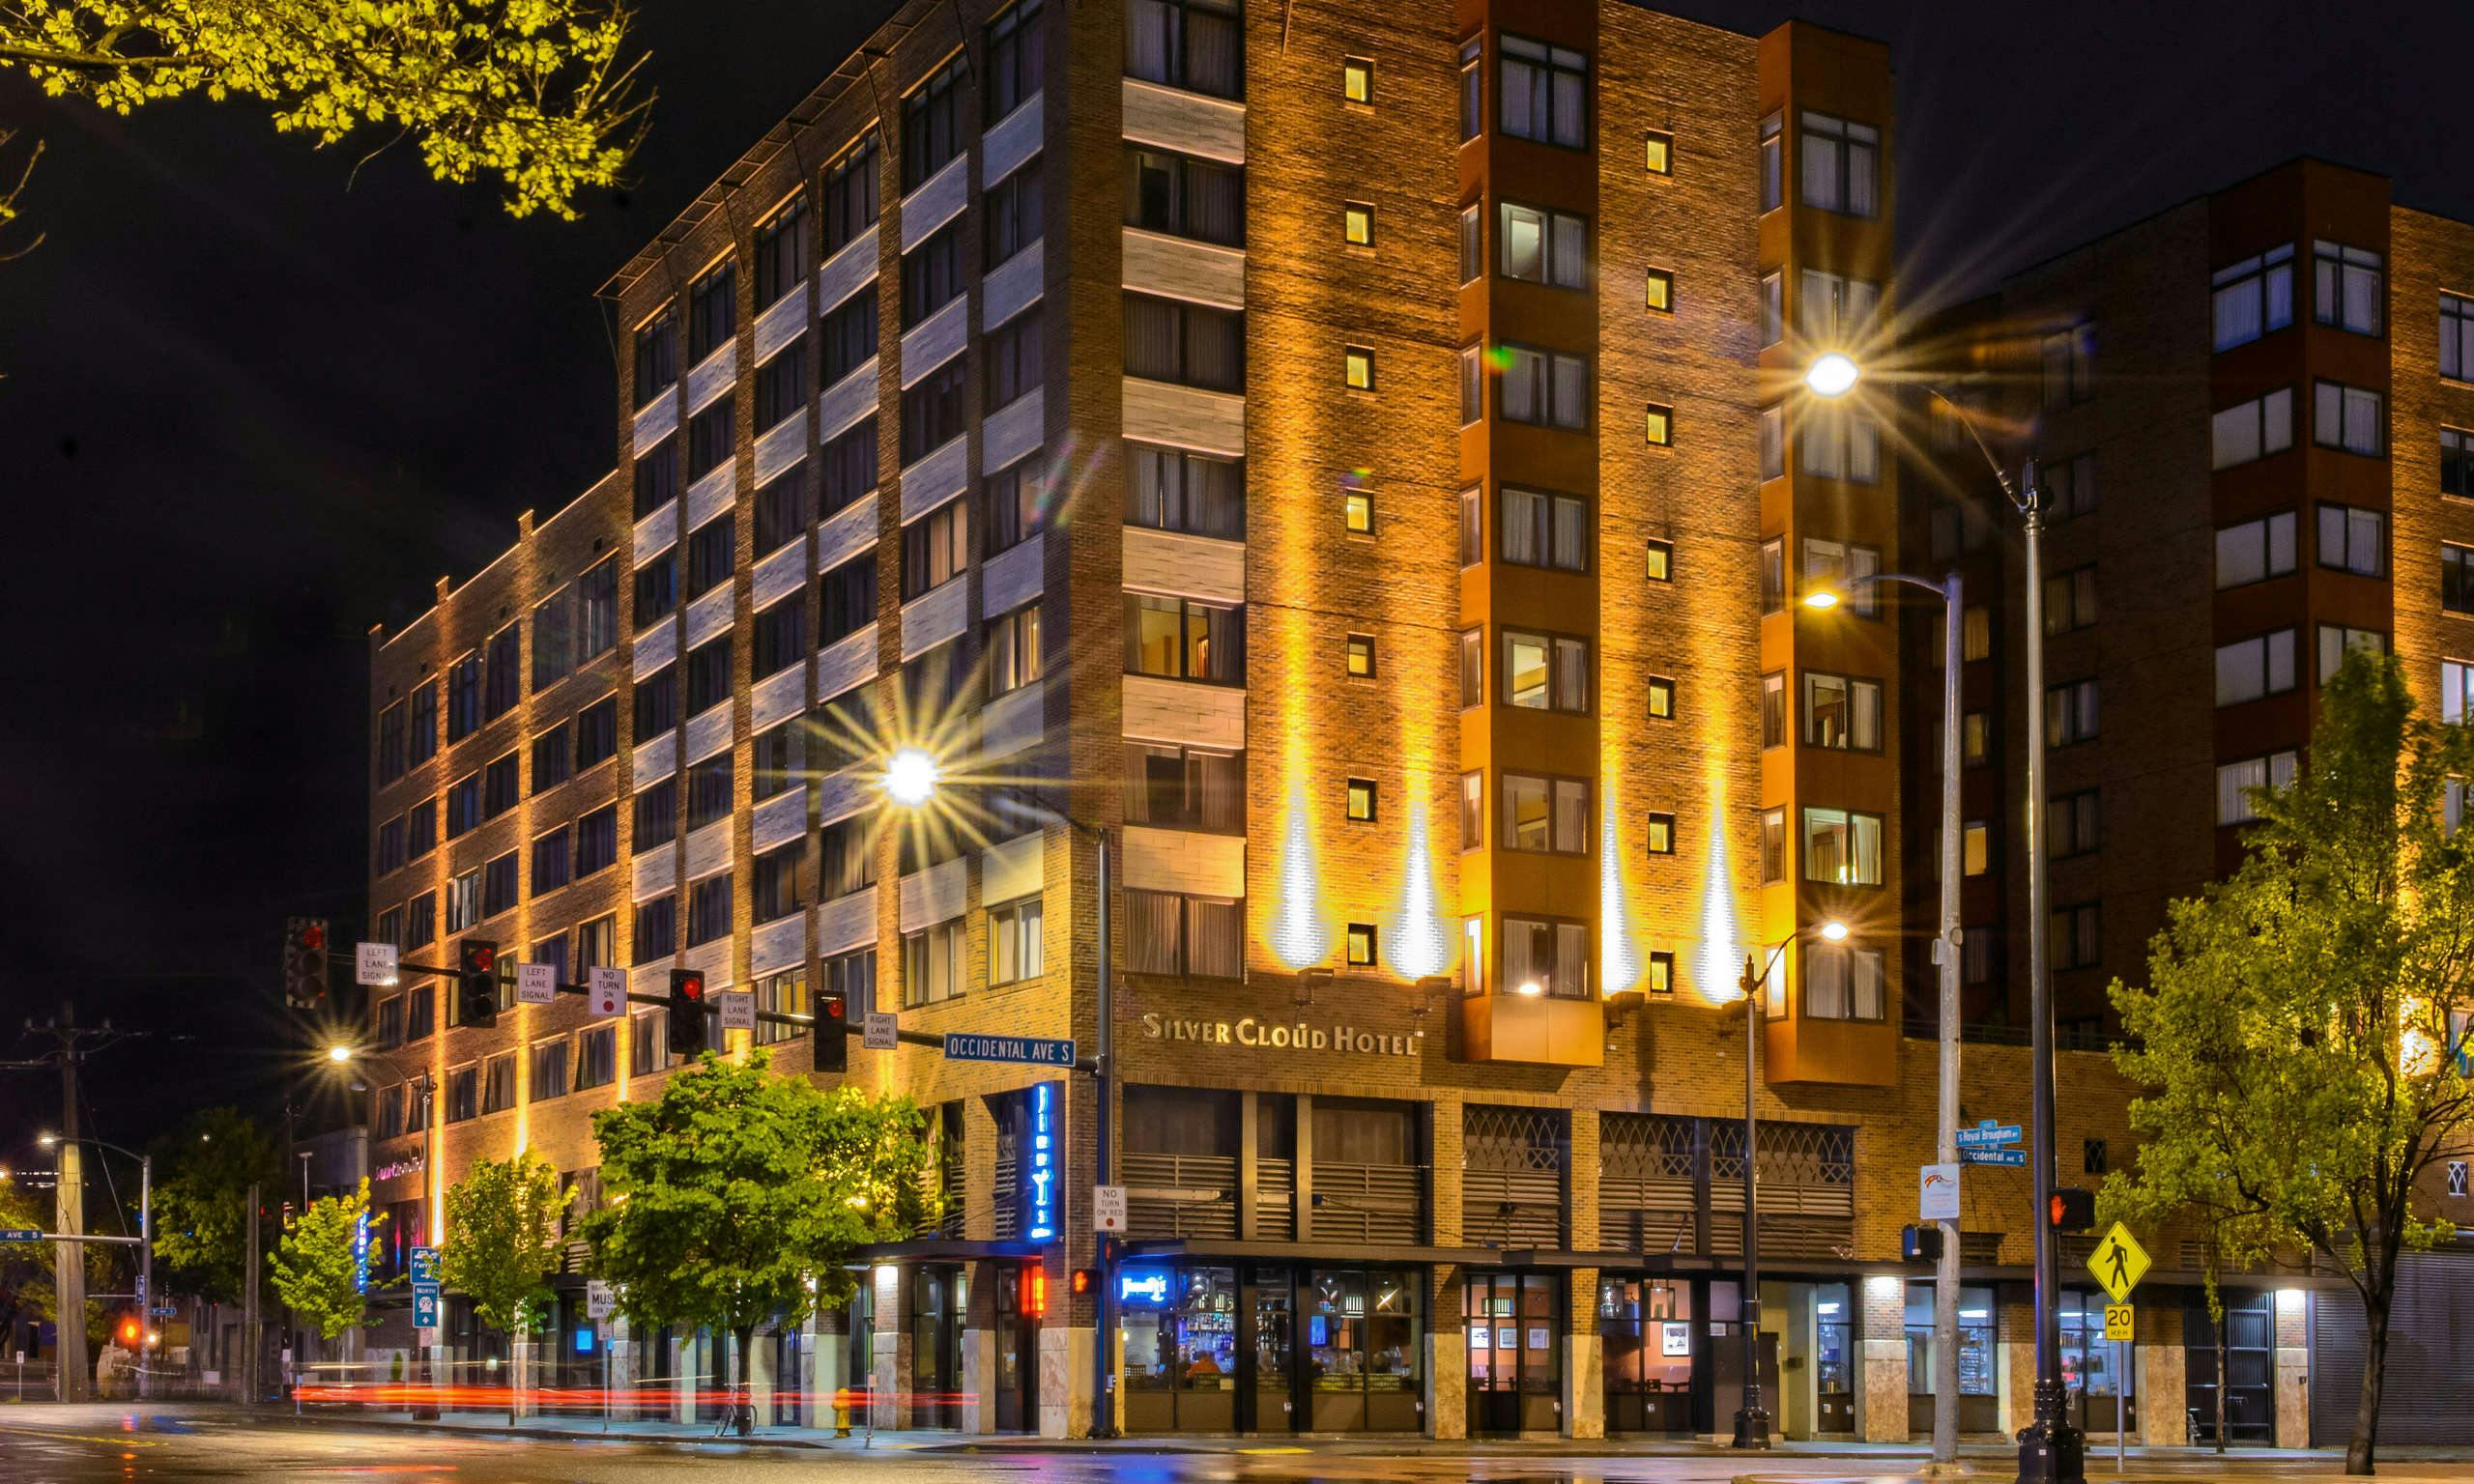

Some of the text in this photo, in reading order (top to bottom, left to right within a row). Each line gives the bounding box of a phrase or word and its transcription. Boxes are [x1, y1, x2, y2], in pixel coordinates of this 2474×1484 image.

[527, 967, 546, 976] LEFT
[602, 971, 615, 980] NO
[525, 980, 547, 988] LANE
[598, 981, 619, 990] TURN
[522, 991, 550, 1000] SIGNAL
[727, 995, 749, 1004] RIGHT
[727, 1006, 748, 1014] LANE
[725, 1017, 752, 1026] SIGNAL
[870, 1015, 891, 1024] RIGHT
[1143, 1012, 1418, 1056] SILVER CLOUD HOTEL
[950, 1037, 1070, 1062] OCCIDENTAL AVE S
[1958, 1132, 1963, 1143] S
[1962, 1150, 2004, 1161] Occidental
[1103, 1189, 1117, 1198] NO
[420, 1298, 431, 1307] 99
[591, 1293, 614, 1304] MUS
[2108, 1309, 2131, 1327] 20
